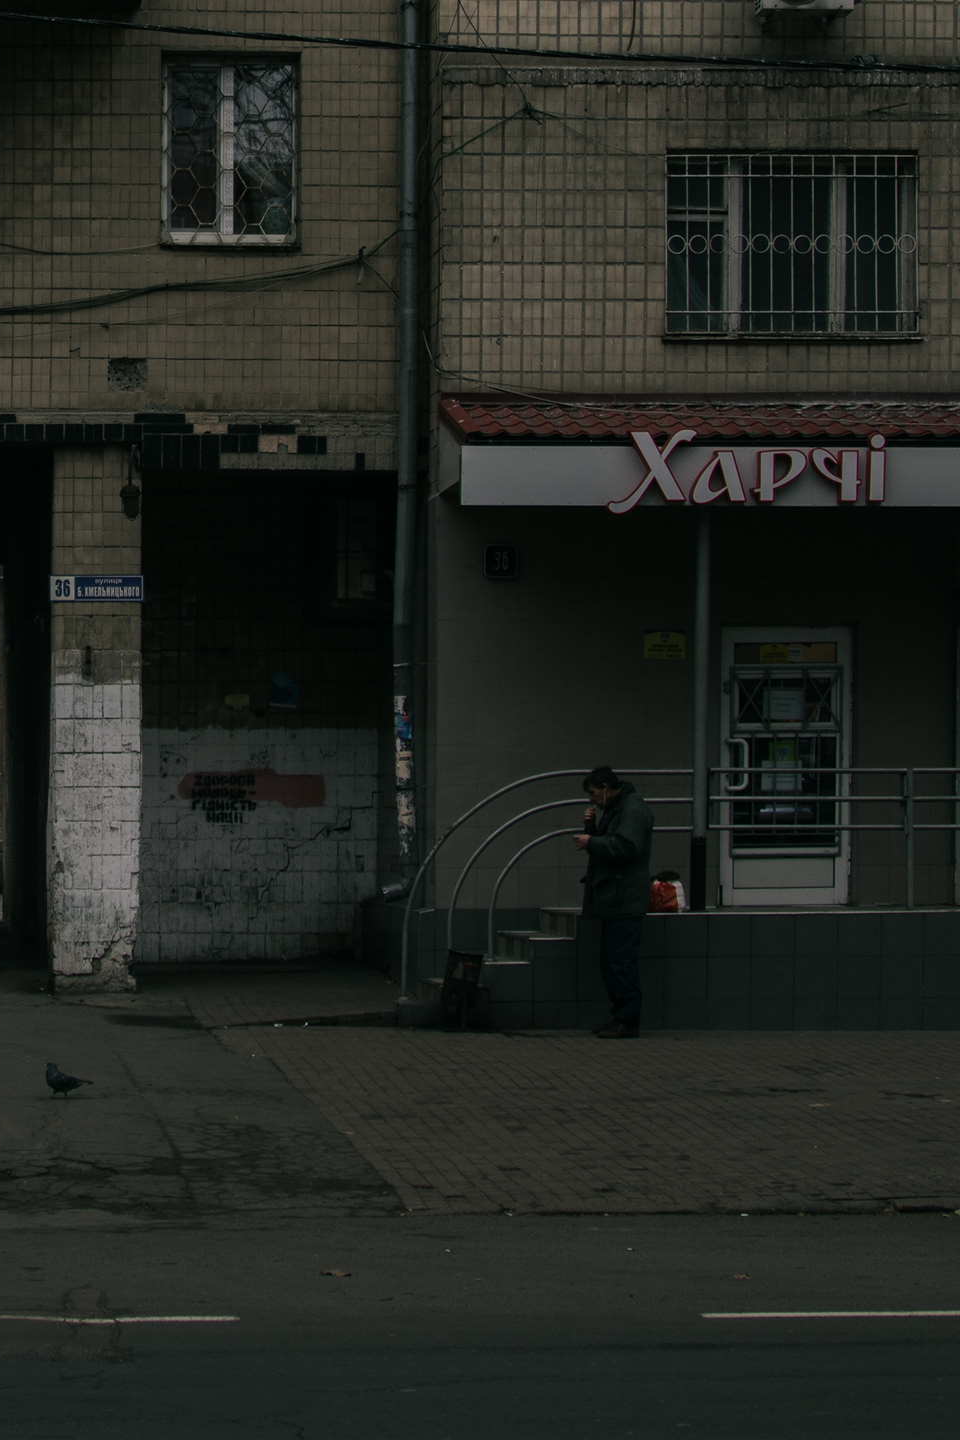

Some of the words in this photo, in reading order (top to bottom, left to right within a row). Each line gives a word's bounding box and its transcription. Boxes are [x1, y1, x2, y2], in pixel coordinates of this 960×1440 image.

[607, 429, 887, 514] Харчі
[493, 551, 508, 570] 36
[55, 579, 70, 597] 36
[77, 586, 84, 597] Б.
[84, 586, 140, 598] ХМЕЛЬНИЦЬКОГО
[191, 799, 257, 811] ГІДНІСТЬ
